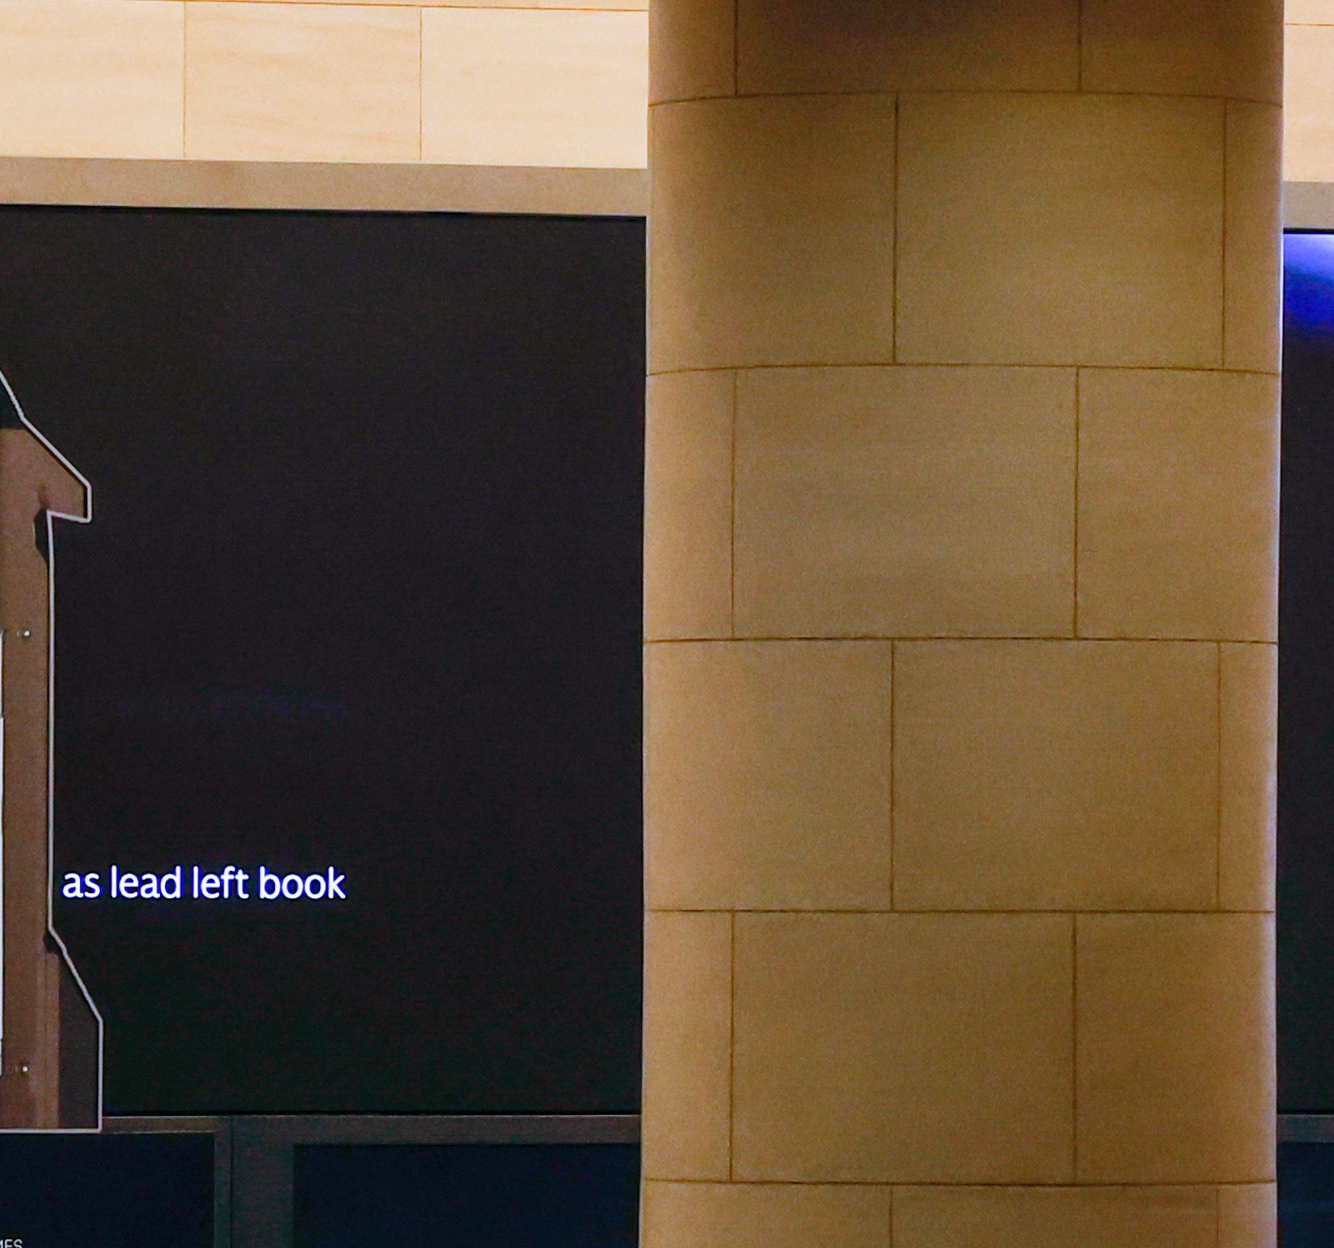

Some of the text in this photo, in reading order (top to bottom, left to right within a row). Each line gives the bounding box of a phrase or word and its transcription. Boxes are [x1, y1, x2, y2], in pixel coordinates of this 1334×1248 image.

[62, 872, 101, 899] as
[111, 865, 181, 899] lead
[192, 865, 250, 899] left
[259, 865, 346, 900] book
